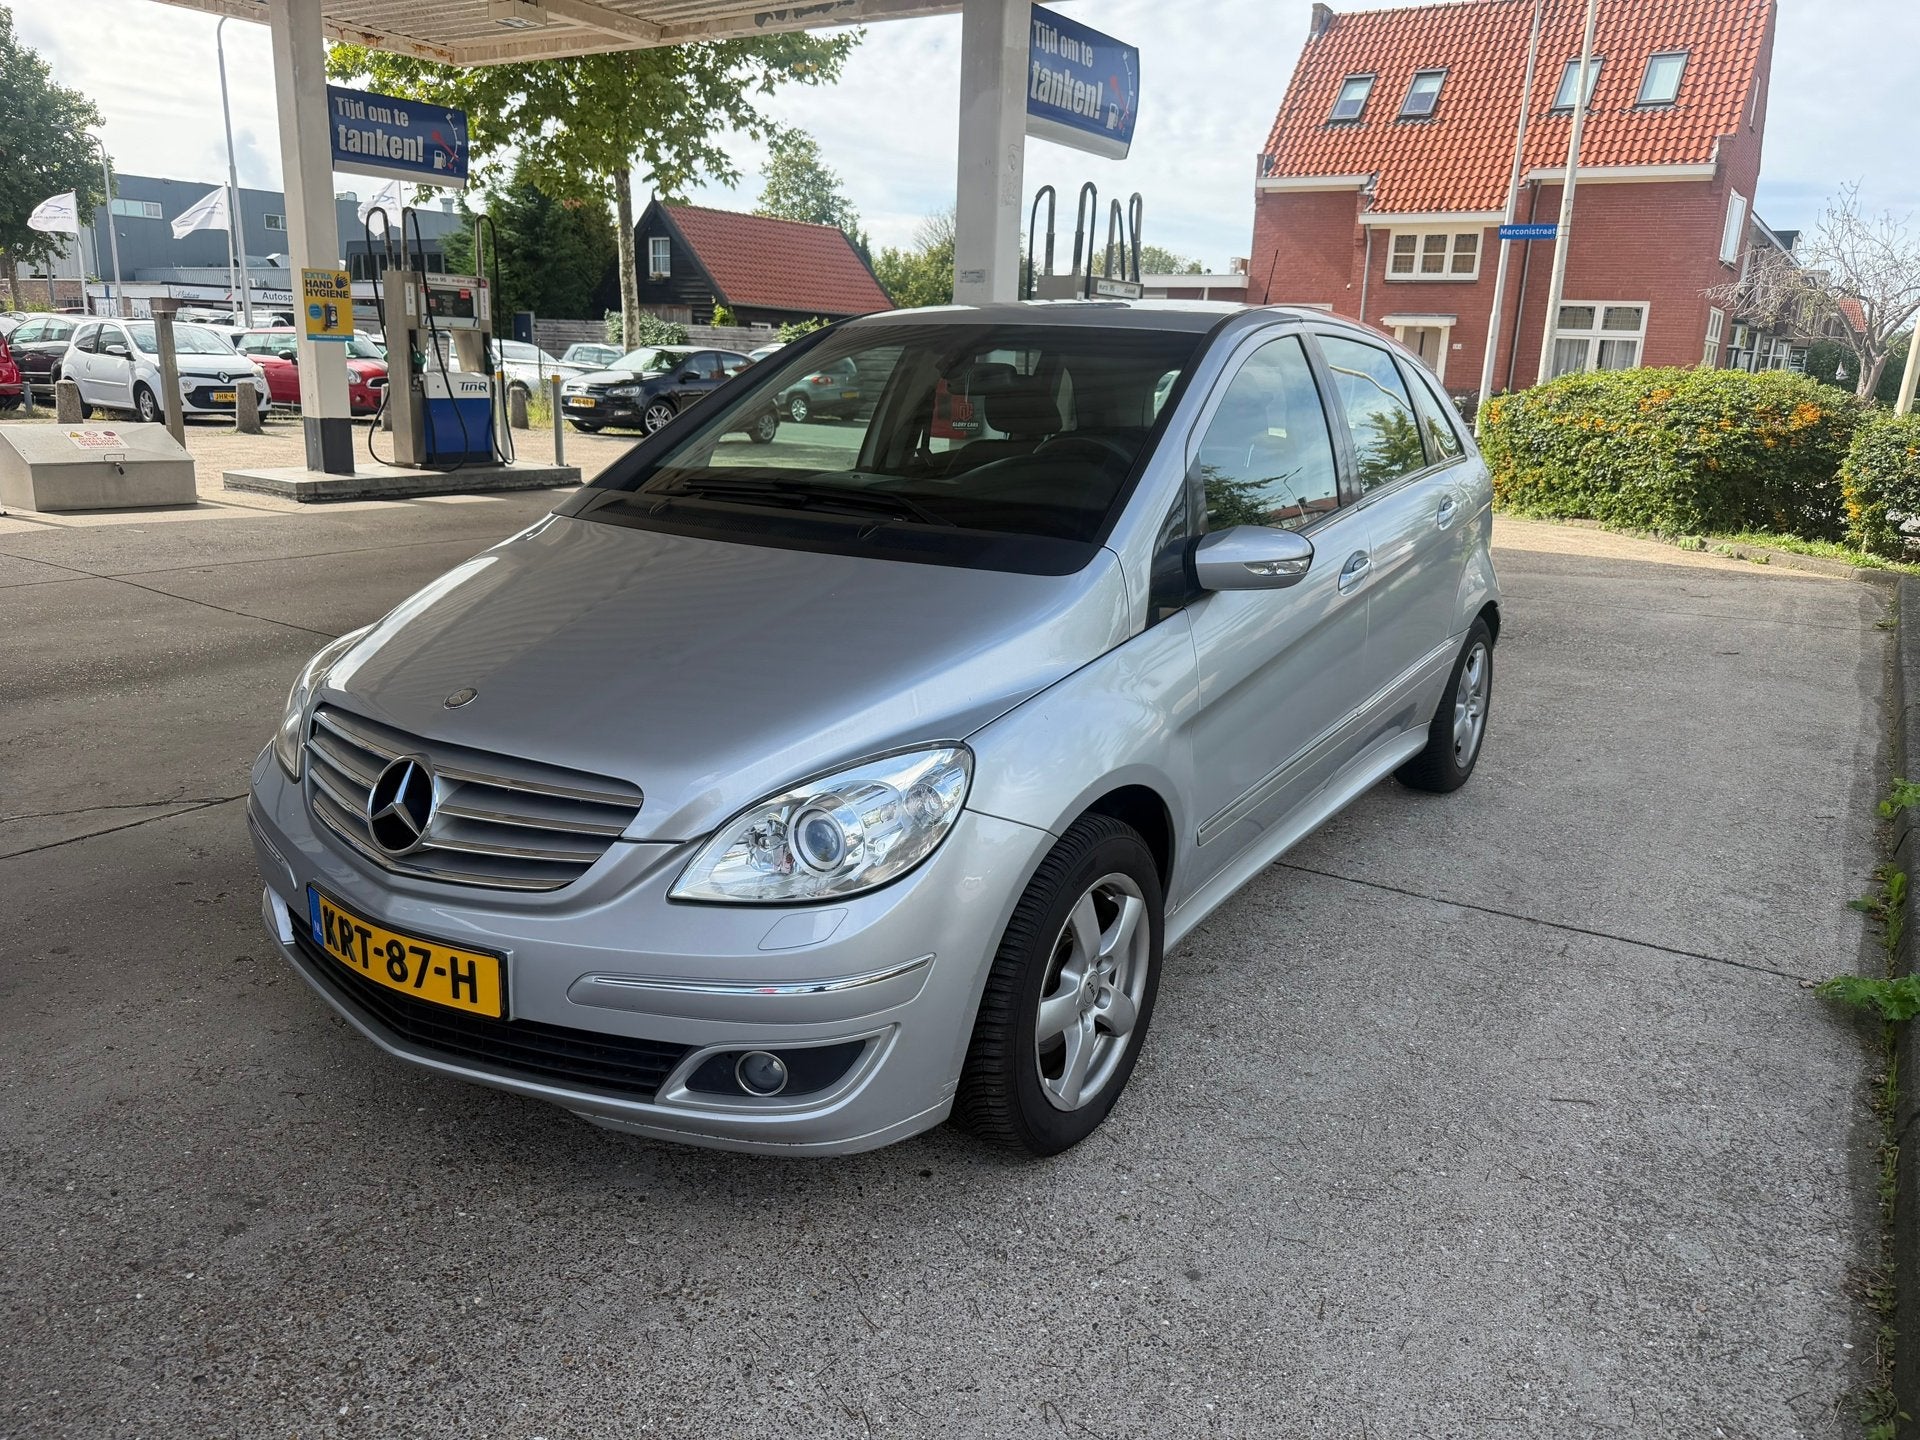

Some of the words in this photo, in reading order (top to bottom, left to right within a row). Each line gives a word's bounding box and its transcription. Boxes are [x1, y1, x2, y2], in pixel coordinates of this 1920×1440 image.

[1033, 19, 1058, 55] Tijd
[1060, 35, 1079, 63] om
[1081, 41, 1093, 68] te
[1030, 60, 1103, 120] tanken!
[335, 96, 365, 120] Tijd
[368, 105, 392, 125] om
[394, 108, 409, 127] te
[338, 124, 424, 163] tanken!
[1500, 227, 1556, 235] Marconistraat
[304, 272, 332, 280] EXTRA
[305, 279, 333, 289] HAND
[305, 287, 350, 299] HYGIENE
[313, 919, 323, 937] NL
[322, 904, 478, 1004] KRT-87-H
